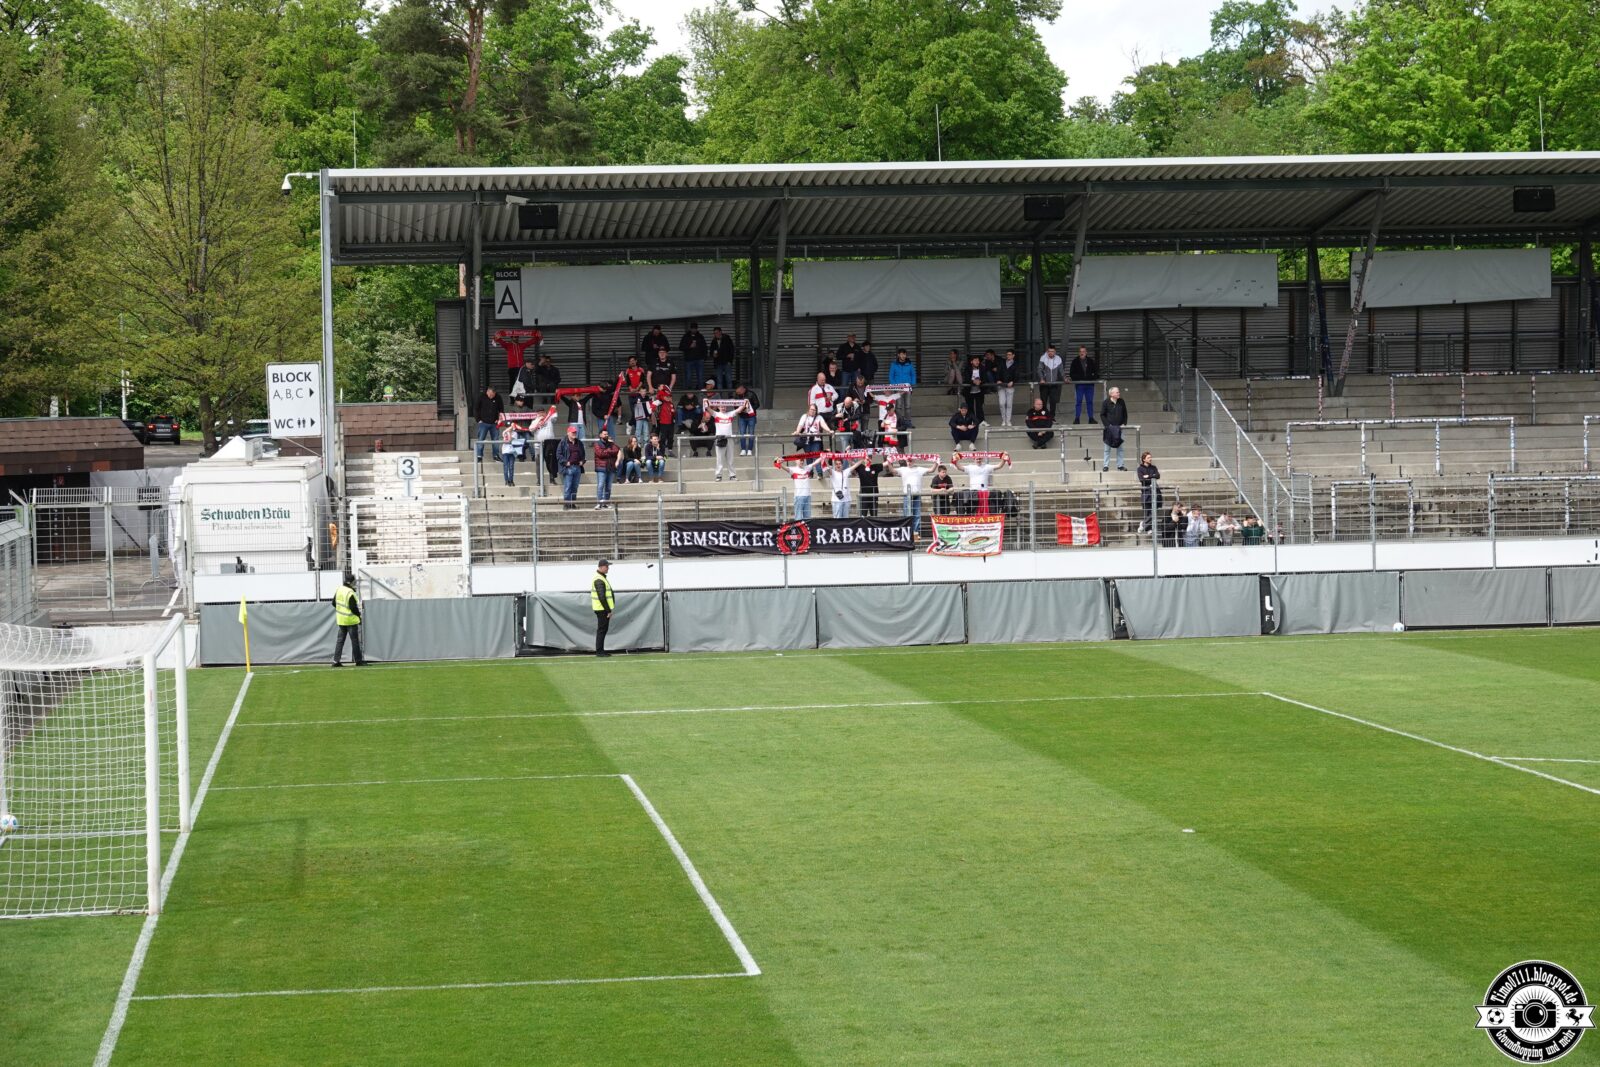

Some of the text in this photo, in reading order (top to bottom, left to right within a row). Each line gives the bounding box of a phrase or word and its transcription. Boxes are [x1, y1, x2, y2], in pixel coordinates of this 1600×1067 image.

[497, 284, 519, 314] A
[272, 372, 312, 383] BLOCK
[274, 419, 294, 429] WC
[402, 458, 415, 476] 3
[200, 506, 291, 520] Schwaben Bräu
[934, 515, 1002, 524] STUTTGART
[670, 530, 775, 547] REMSECKER
[816, 526, 911, 545] RABAUKEN
